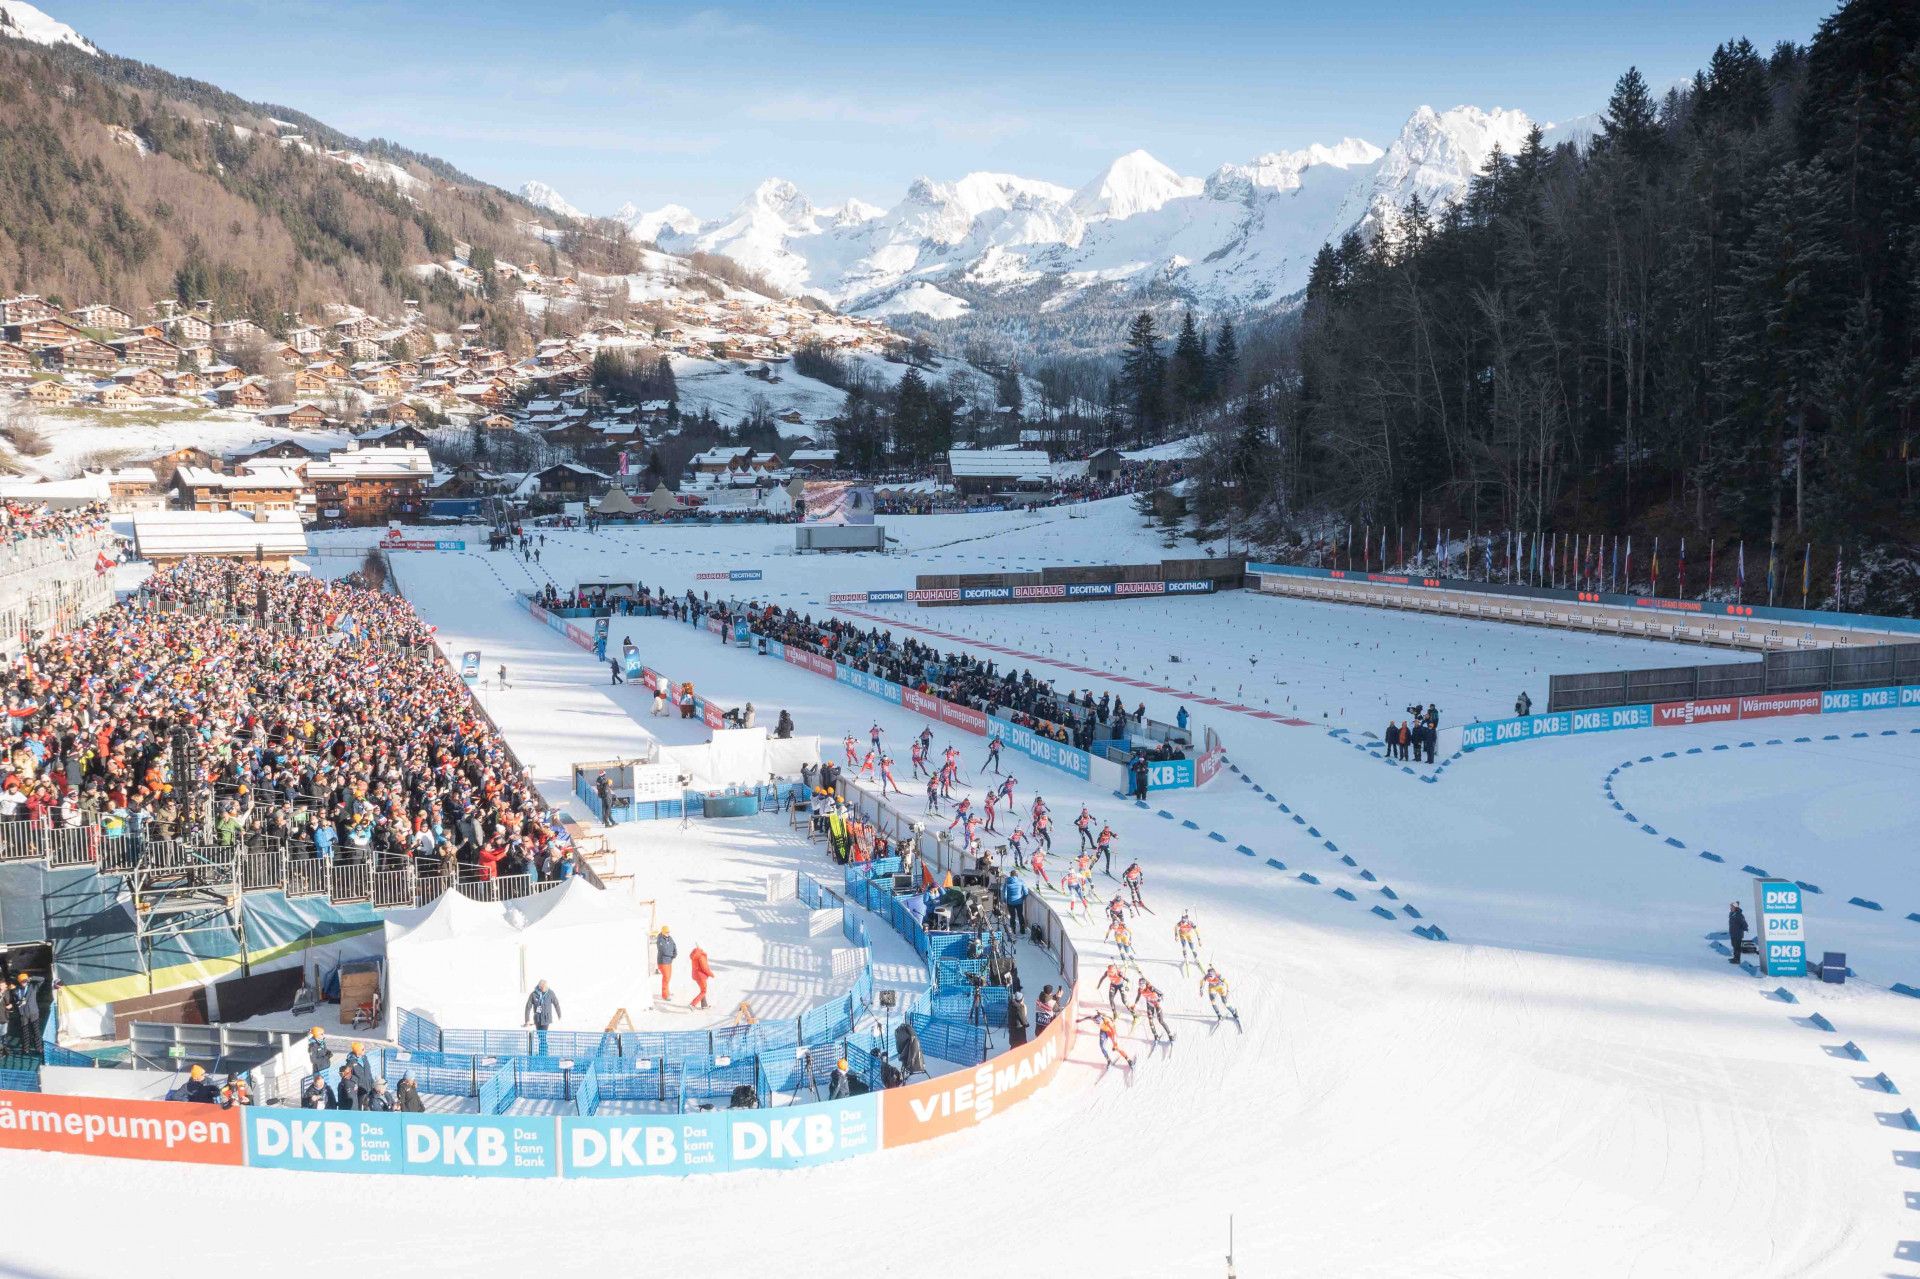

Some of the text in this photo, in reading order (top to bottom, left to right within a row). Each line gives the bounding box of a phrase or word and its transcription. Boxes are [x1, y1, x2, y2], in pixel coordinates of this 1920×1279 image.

[1015, 585, 1065, 597] BAUHAUS
[1069, 585, 1111, 595] DECATHLON
[1117, 583, 1164, 593] BAUHAUS
[1168, 581, 1209, 591] DECATHLON
[907, 589, 960, 600] BAUHAUS
[965, 588, 1009, 598] DECATHLON
[1743, 697, 1819, 713] Wärmepumpen
[1823, 693, 1850, 709] DKB
[1862, 691, 1888, 707] DKB
[942, 703, 986, 729] Wärmepumpen
[1612, 709, 1638, 726] DKB
[1661, 702, 1731, 723] VIESSMANN
[1533, 717, 1560, 735] DKB
[1574, 712, 1600, 728] DKB
[1464, 727, 1485, 746] DKB
[1496, 722, 1522, 740] DKB
[1030, 738, 1051, 760] DKB
[1059, 747, 1080, 771] DKB
[1147, 766, 1175, 786] KB
[1766, 891, 1798, 904] DKB
[1769, 919, 1799, 930] DKB
[1770, 945, 1801, 958] DKB
[909, 1036, 1057, 1123] VIESSMANN
[840, 1109, 862, 1122] Das
[360, 1123, 384, 1136] Das
[514, 1128, 538, 1141] Das
[684, 1125, 707, 1138] Das
[256, 1117, 355, 1161] DKB
[361, 1137, 390, 1149] kann
[731, 1113, 835, 1161] DKB
[406, 1124, 508, 1167] DKB
[514, 1142, 544, 1154] kann
[572, 1126, 678, 1168] DKB
[684, 1139, 714, 1151] kann
[361, 1150, 392, 1163] Bank
[514, 1155, 546, 1168] Bank
[684, 1152, 716, 1165] Bank
